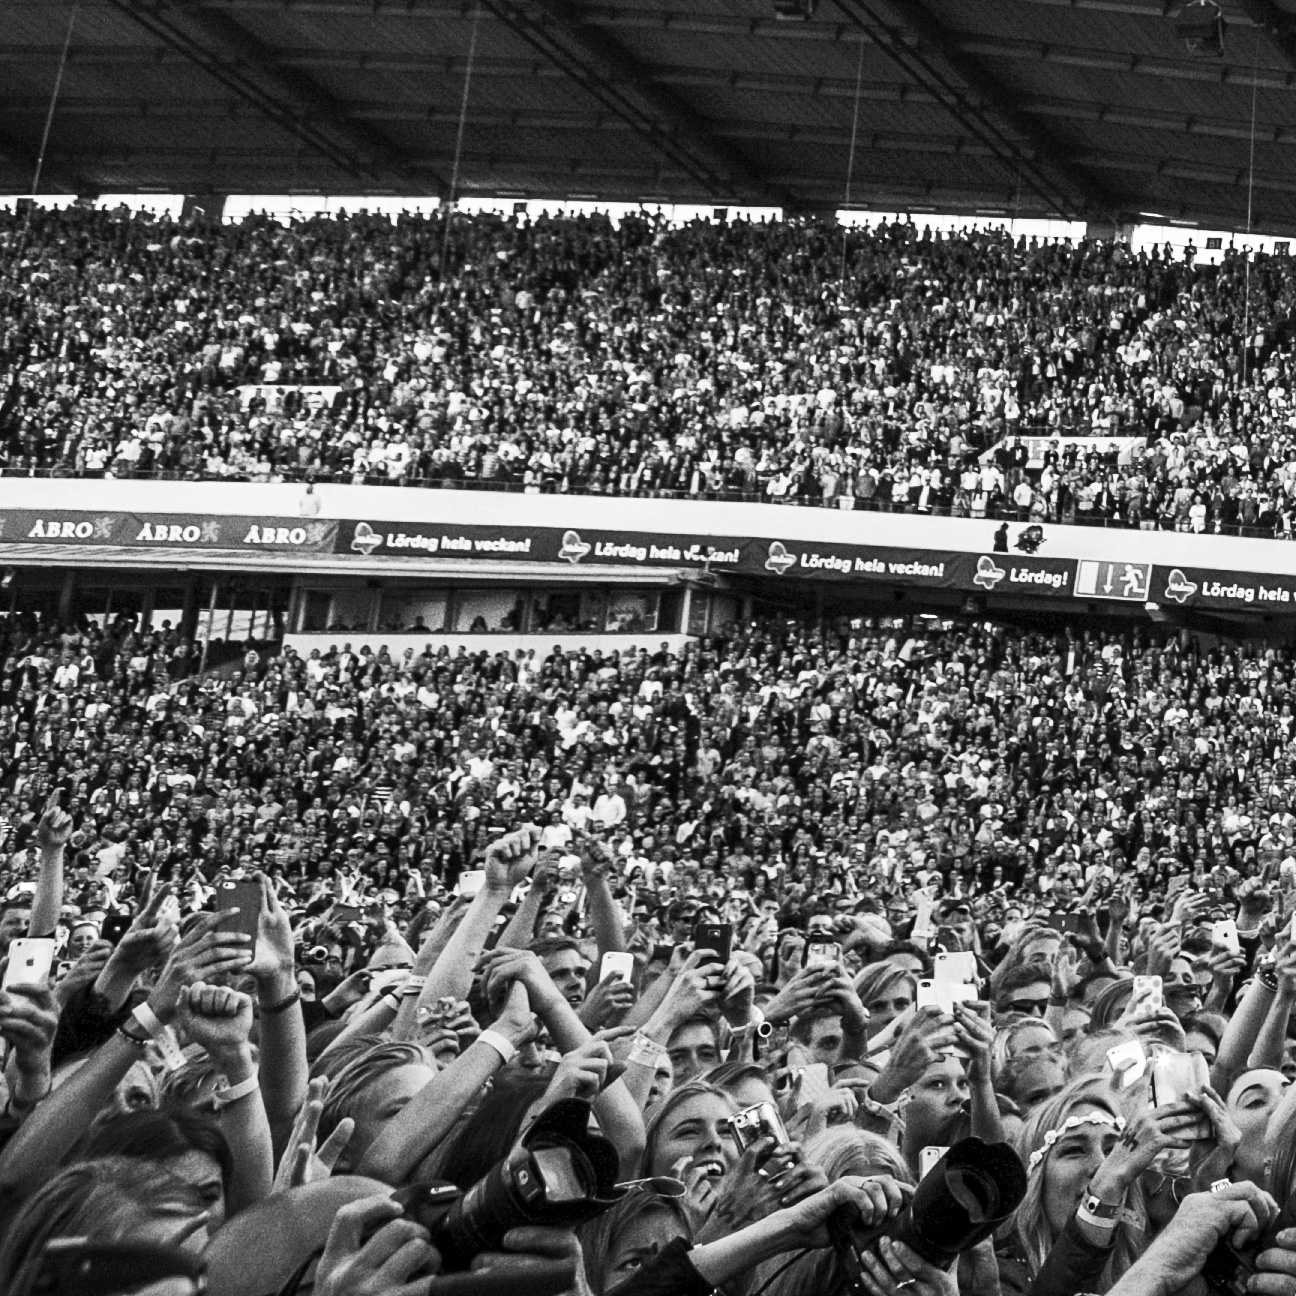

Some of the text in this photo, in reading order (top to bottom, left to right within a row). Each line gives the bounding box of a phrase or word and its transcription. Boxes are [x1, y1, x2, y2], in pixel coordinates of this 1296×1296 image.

[28, 519, 94, 538] ÅBRO
[136, 522, 201, 542] ÅBRO
[243, 524, 307, 544] ÅBRO
[387, 533, 438, 552] Lördag
[594, 542, 646, 561] Lördag
[649, 546, 681, 560] hela
[801, 553, 851, 573] Lördag
[854, 557, 886, 573] hela
[888, 560, 944, 577] veckan!
[1010, 568, 1068, 588] Lördag!
[1202, 582, 1254, 602] Lördag
[1258, 585, 1290, 602] hela
